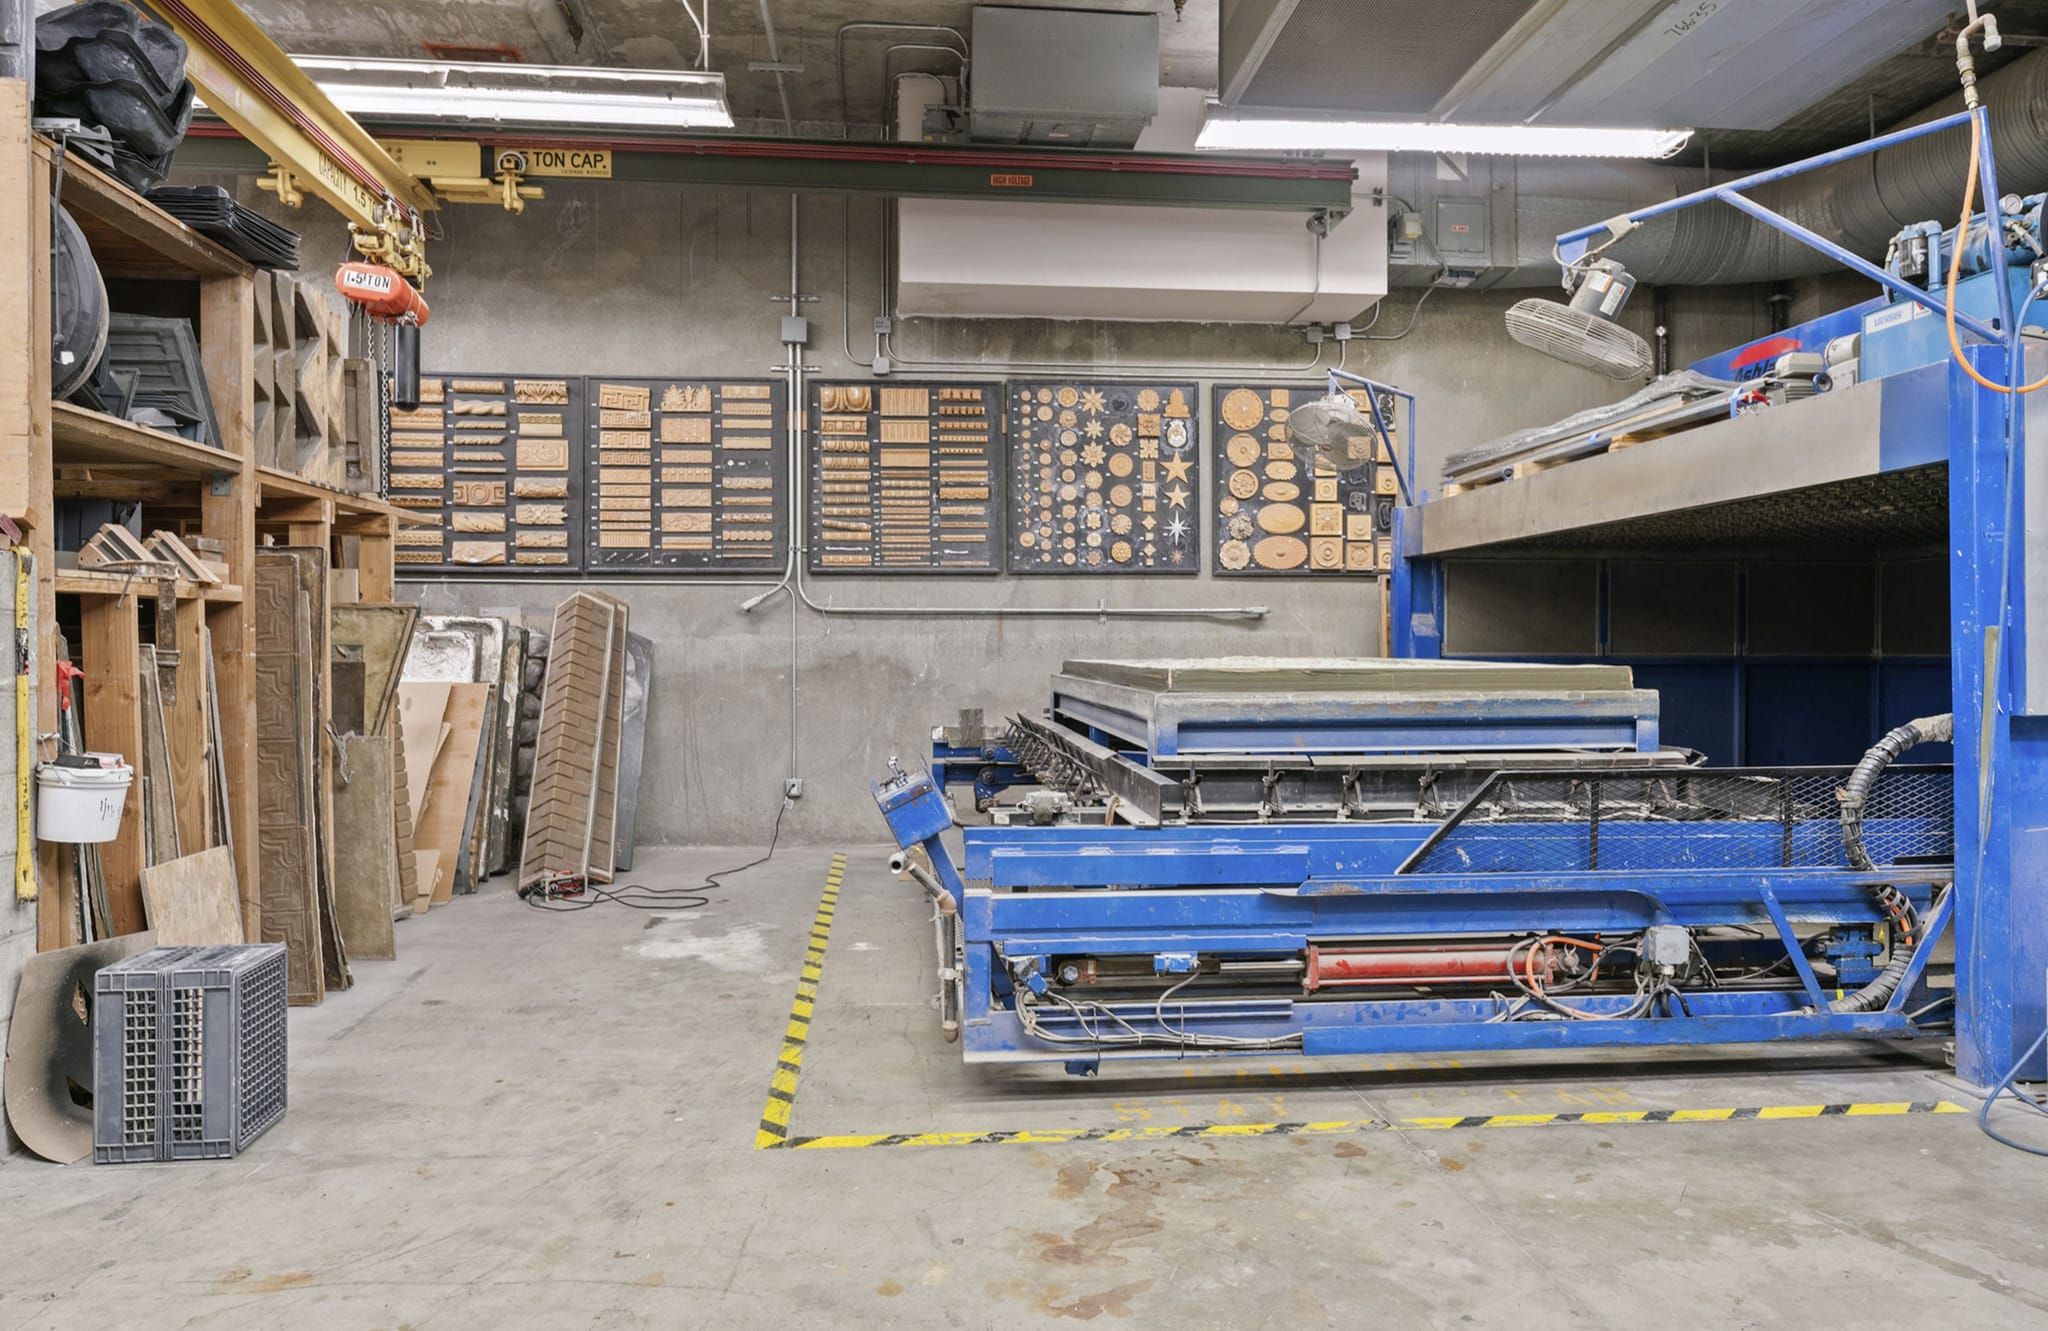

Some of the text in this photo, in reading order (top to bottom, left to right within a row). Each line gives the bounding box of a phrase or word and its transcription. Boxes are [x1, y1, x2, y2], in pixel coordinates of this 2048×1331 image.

[533, 151, 565, 168] TON
[570, 152, 607, 169] CAP.
[319, 151, 347, 195] CAPACITY
[353, 185, 366, 208] 1.5
[992, 175, 1030, 185] HIGH VOLTAGE
[346, 272, 390, 289] 1.5 TON
